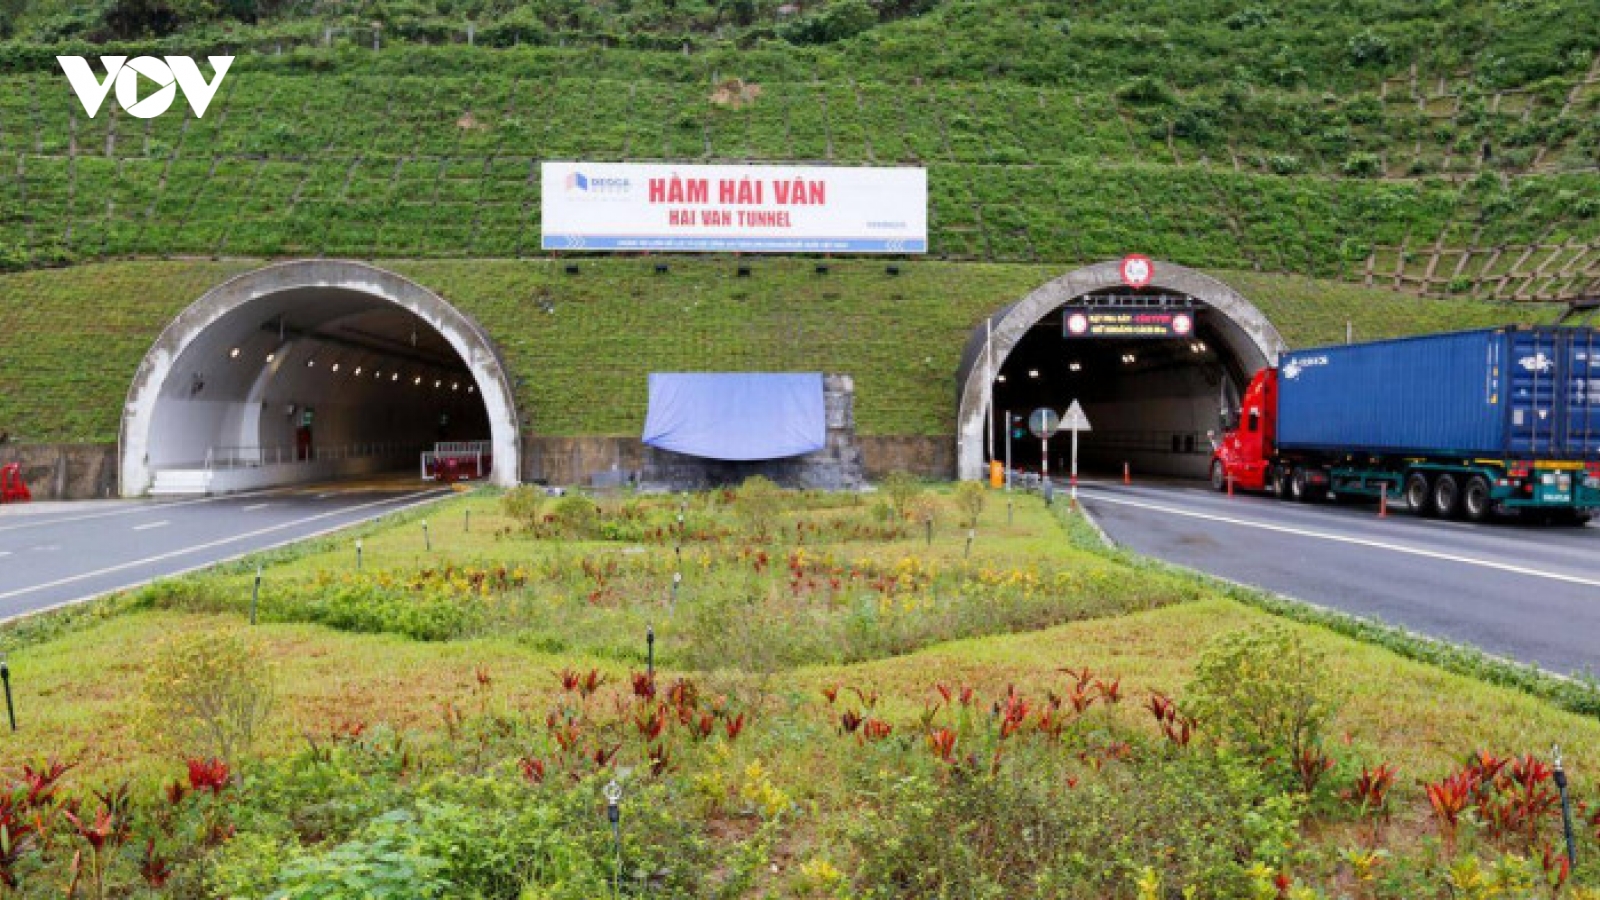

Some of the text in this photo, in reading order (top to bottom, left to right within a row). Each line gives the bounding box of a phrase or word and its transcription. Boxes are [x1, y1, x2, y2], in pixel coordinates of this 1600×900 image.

[772, 176, 826, 205] VÂN
[701, 210, 732, 227] VAN
[737, 210, 792, 228] TUNNEL
